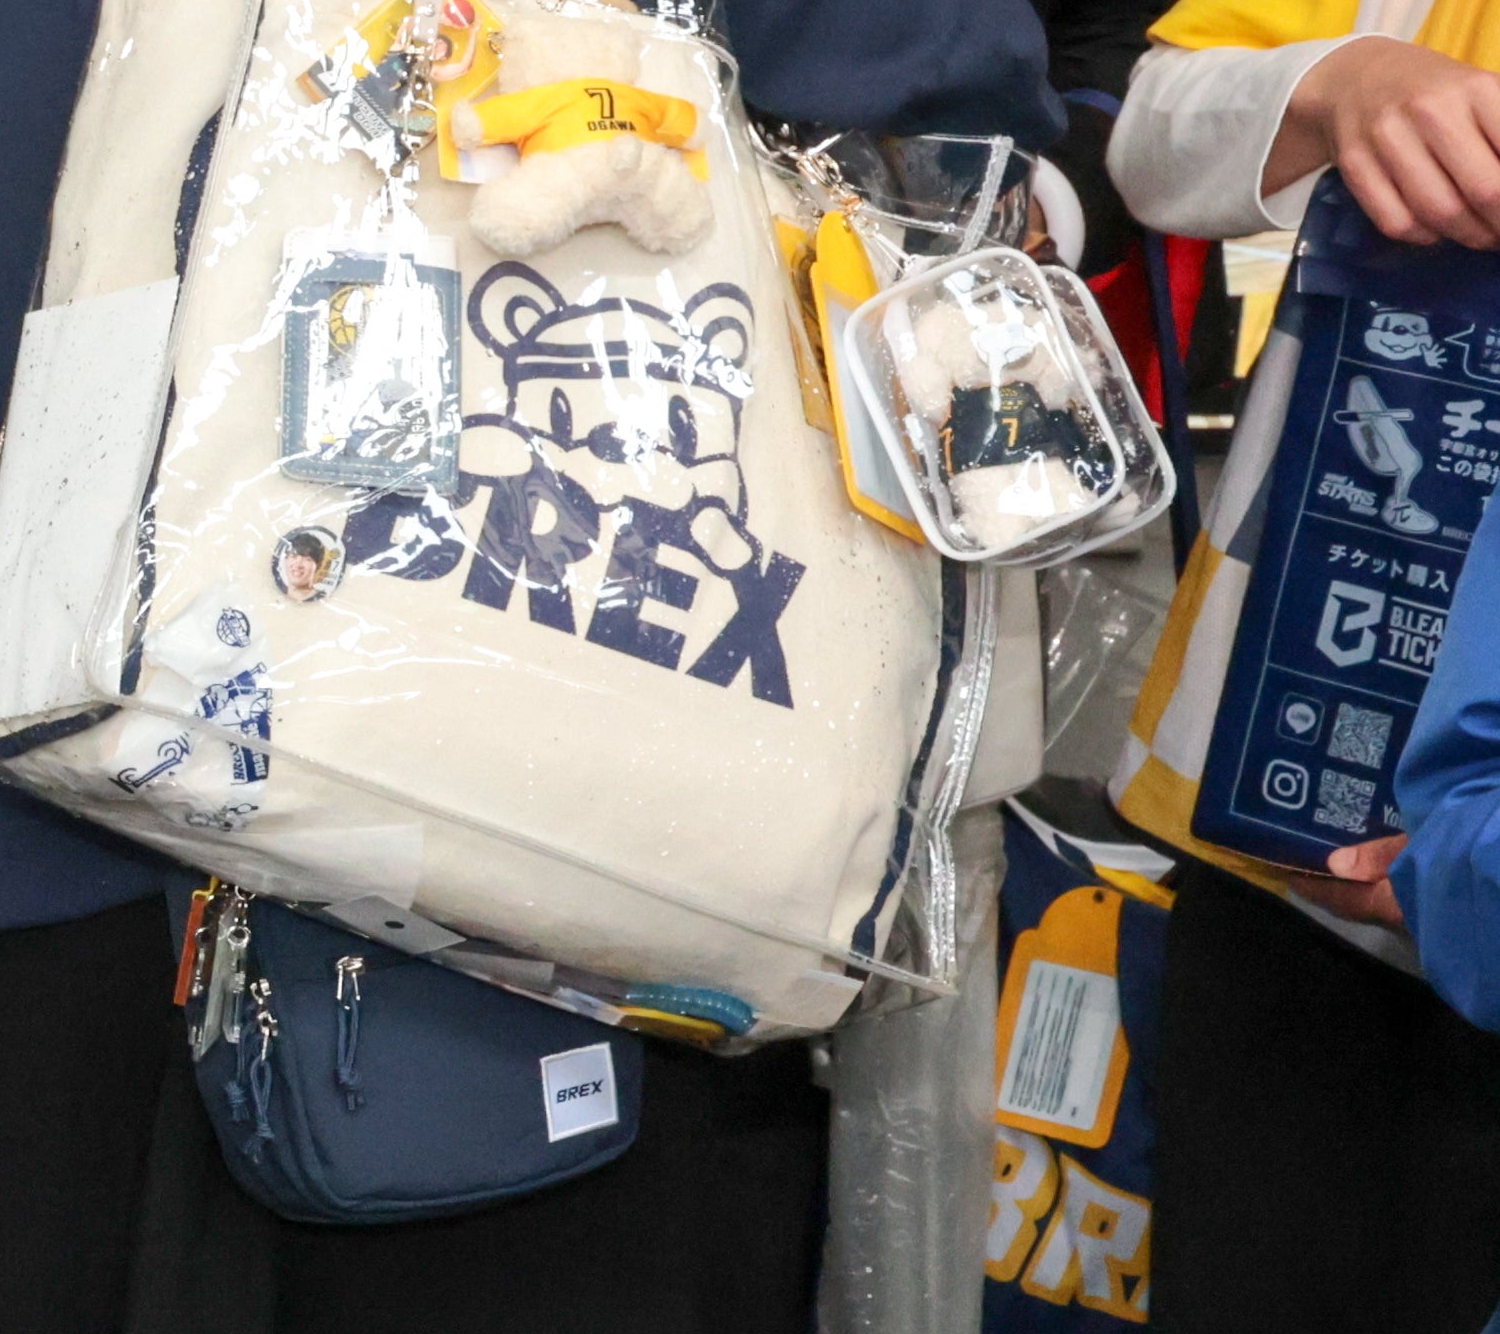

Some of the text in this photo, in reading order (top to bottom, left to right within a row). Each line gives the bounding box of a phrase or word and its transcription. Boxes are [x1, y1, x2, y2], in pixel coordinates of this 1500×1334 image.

[585, 87, 615, 119] 7
[588, 120, 637, 133] OGAWA
[556, 1079, 604, 1104] BREX
